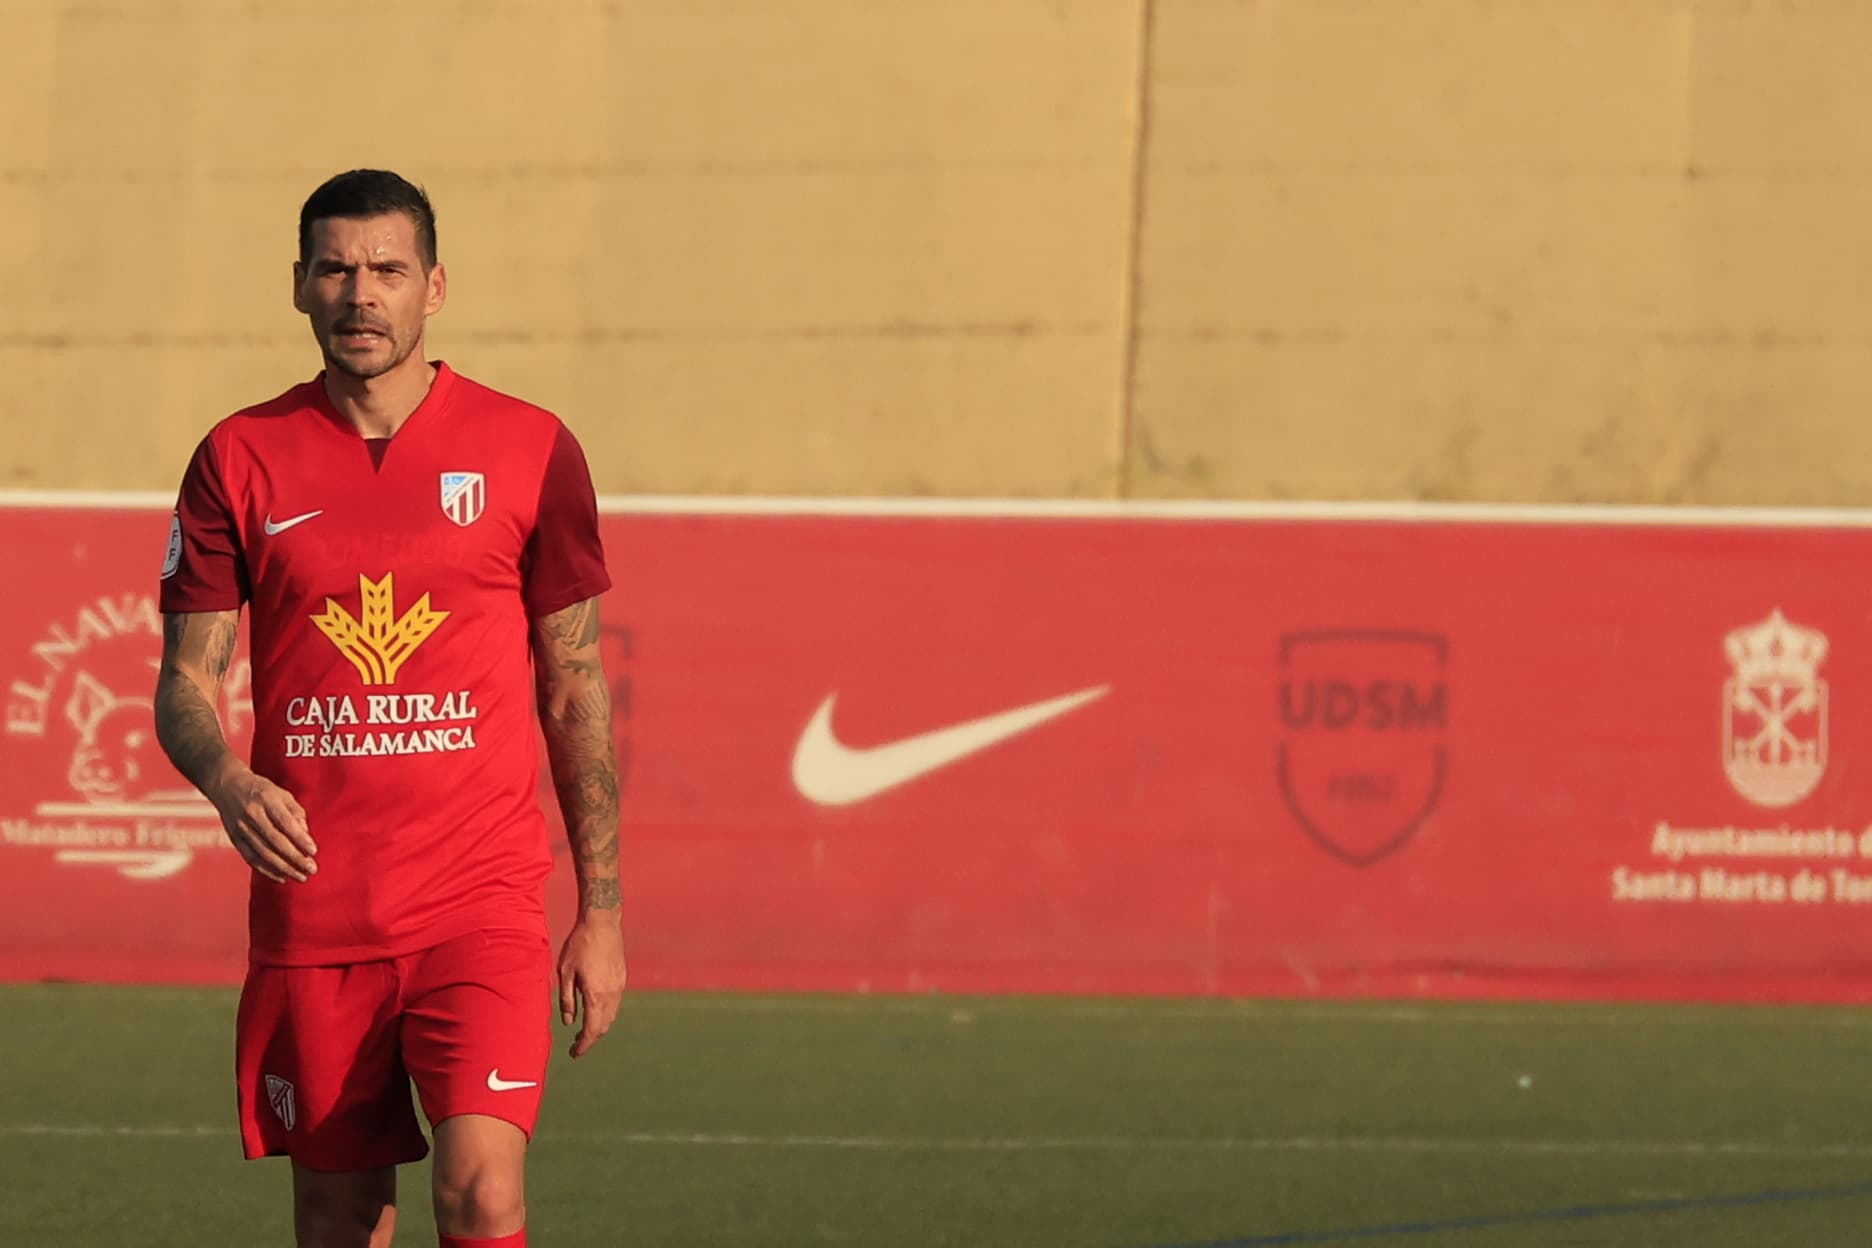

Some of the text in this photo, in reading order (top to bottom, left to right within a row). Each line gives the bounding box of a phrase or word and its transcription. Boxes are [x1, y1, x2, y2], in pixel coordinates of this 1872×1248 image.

[32, 591, 164, 672] NAVA
[287, 691, 476, 732] CAJA RURAL
[1279, 680, 1448, 730] UDSM
[285, 726, 475, 757] DE SALAMANCA
[1651, 820, 1855, 863] Ayuntamiento
[1612, 867, 1697, 901] Santa
[1700, 867, 1786, 902] Marta
[1790, 867, 1827, 903] de
